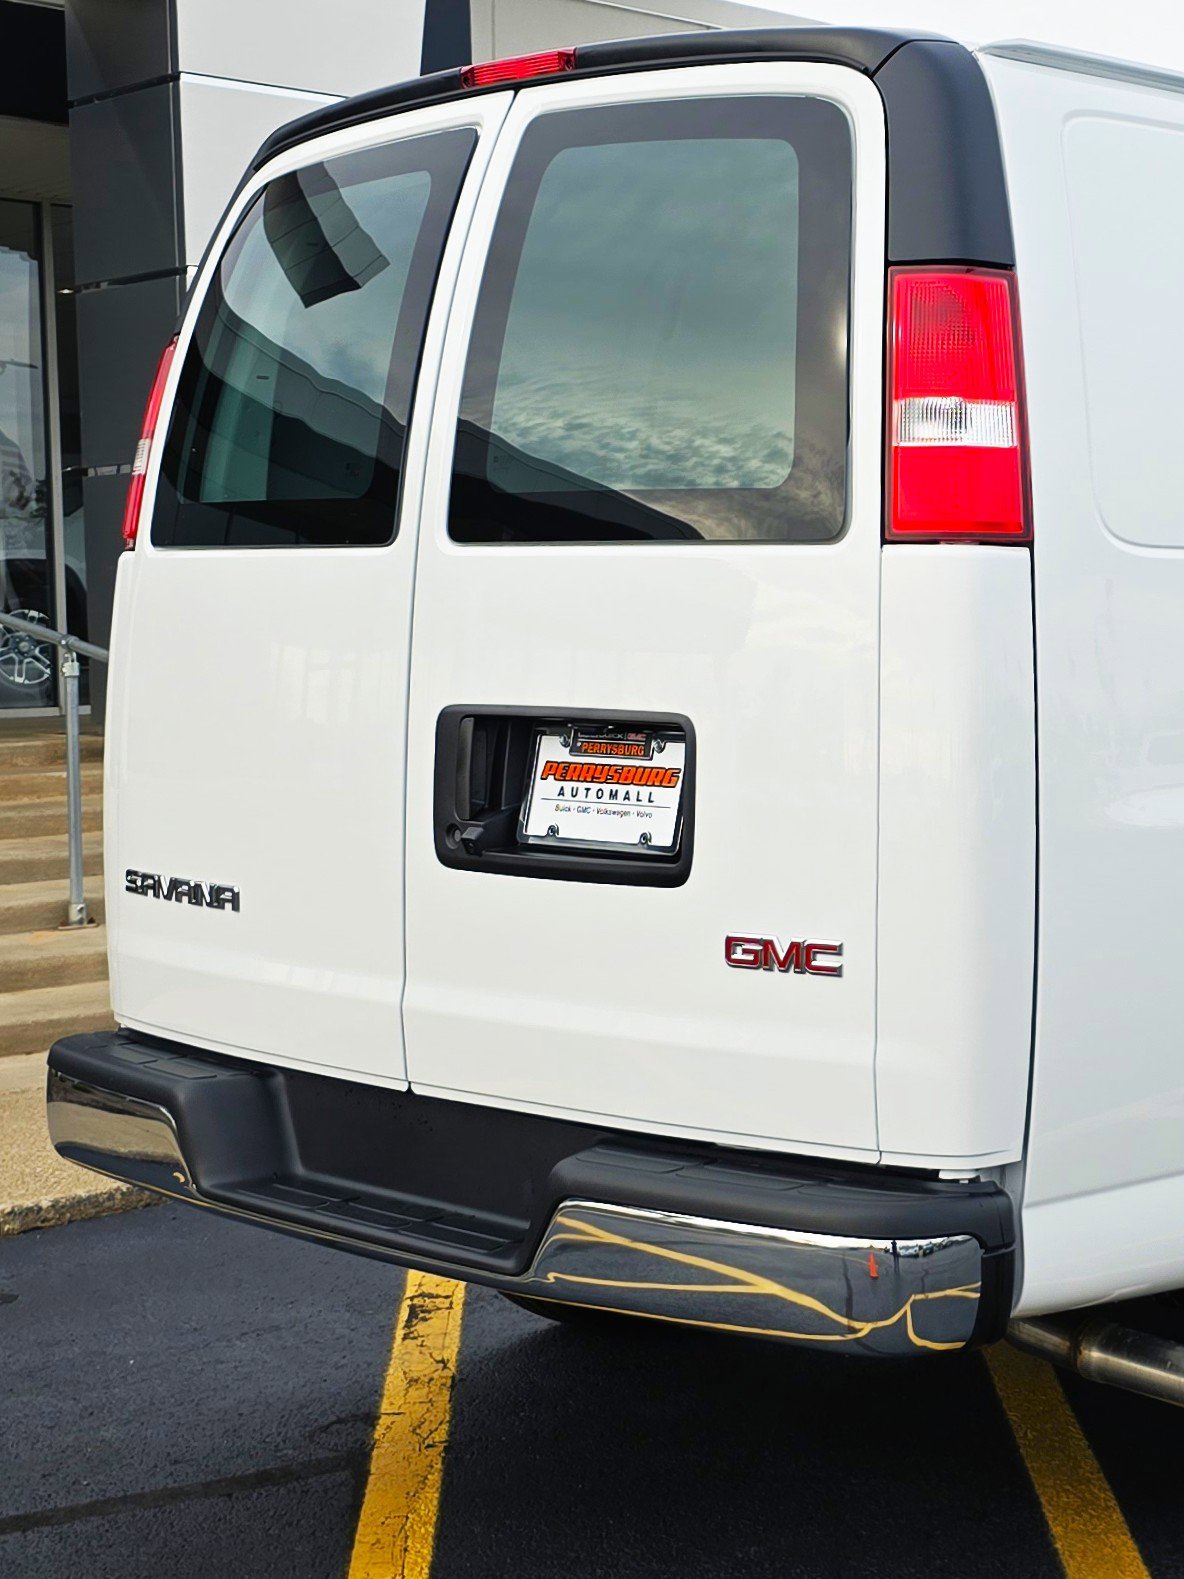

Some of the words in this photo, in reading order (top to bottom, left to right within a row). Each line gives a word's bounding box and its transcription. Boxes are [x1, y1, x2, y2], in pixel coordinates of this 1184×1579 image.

[581, 742, 645, 756] PERRYSBURG
[540, 760, 682, 788] PERRYSBURG
[557, 786, 655, 803] AUTOMALL
[577, 805, 591, 814] GMC
[596, 808, 631, 818] Volkswagen
[125, 869, 240, 913] SAVANA
[725, 932, 843, 978] GMC
